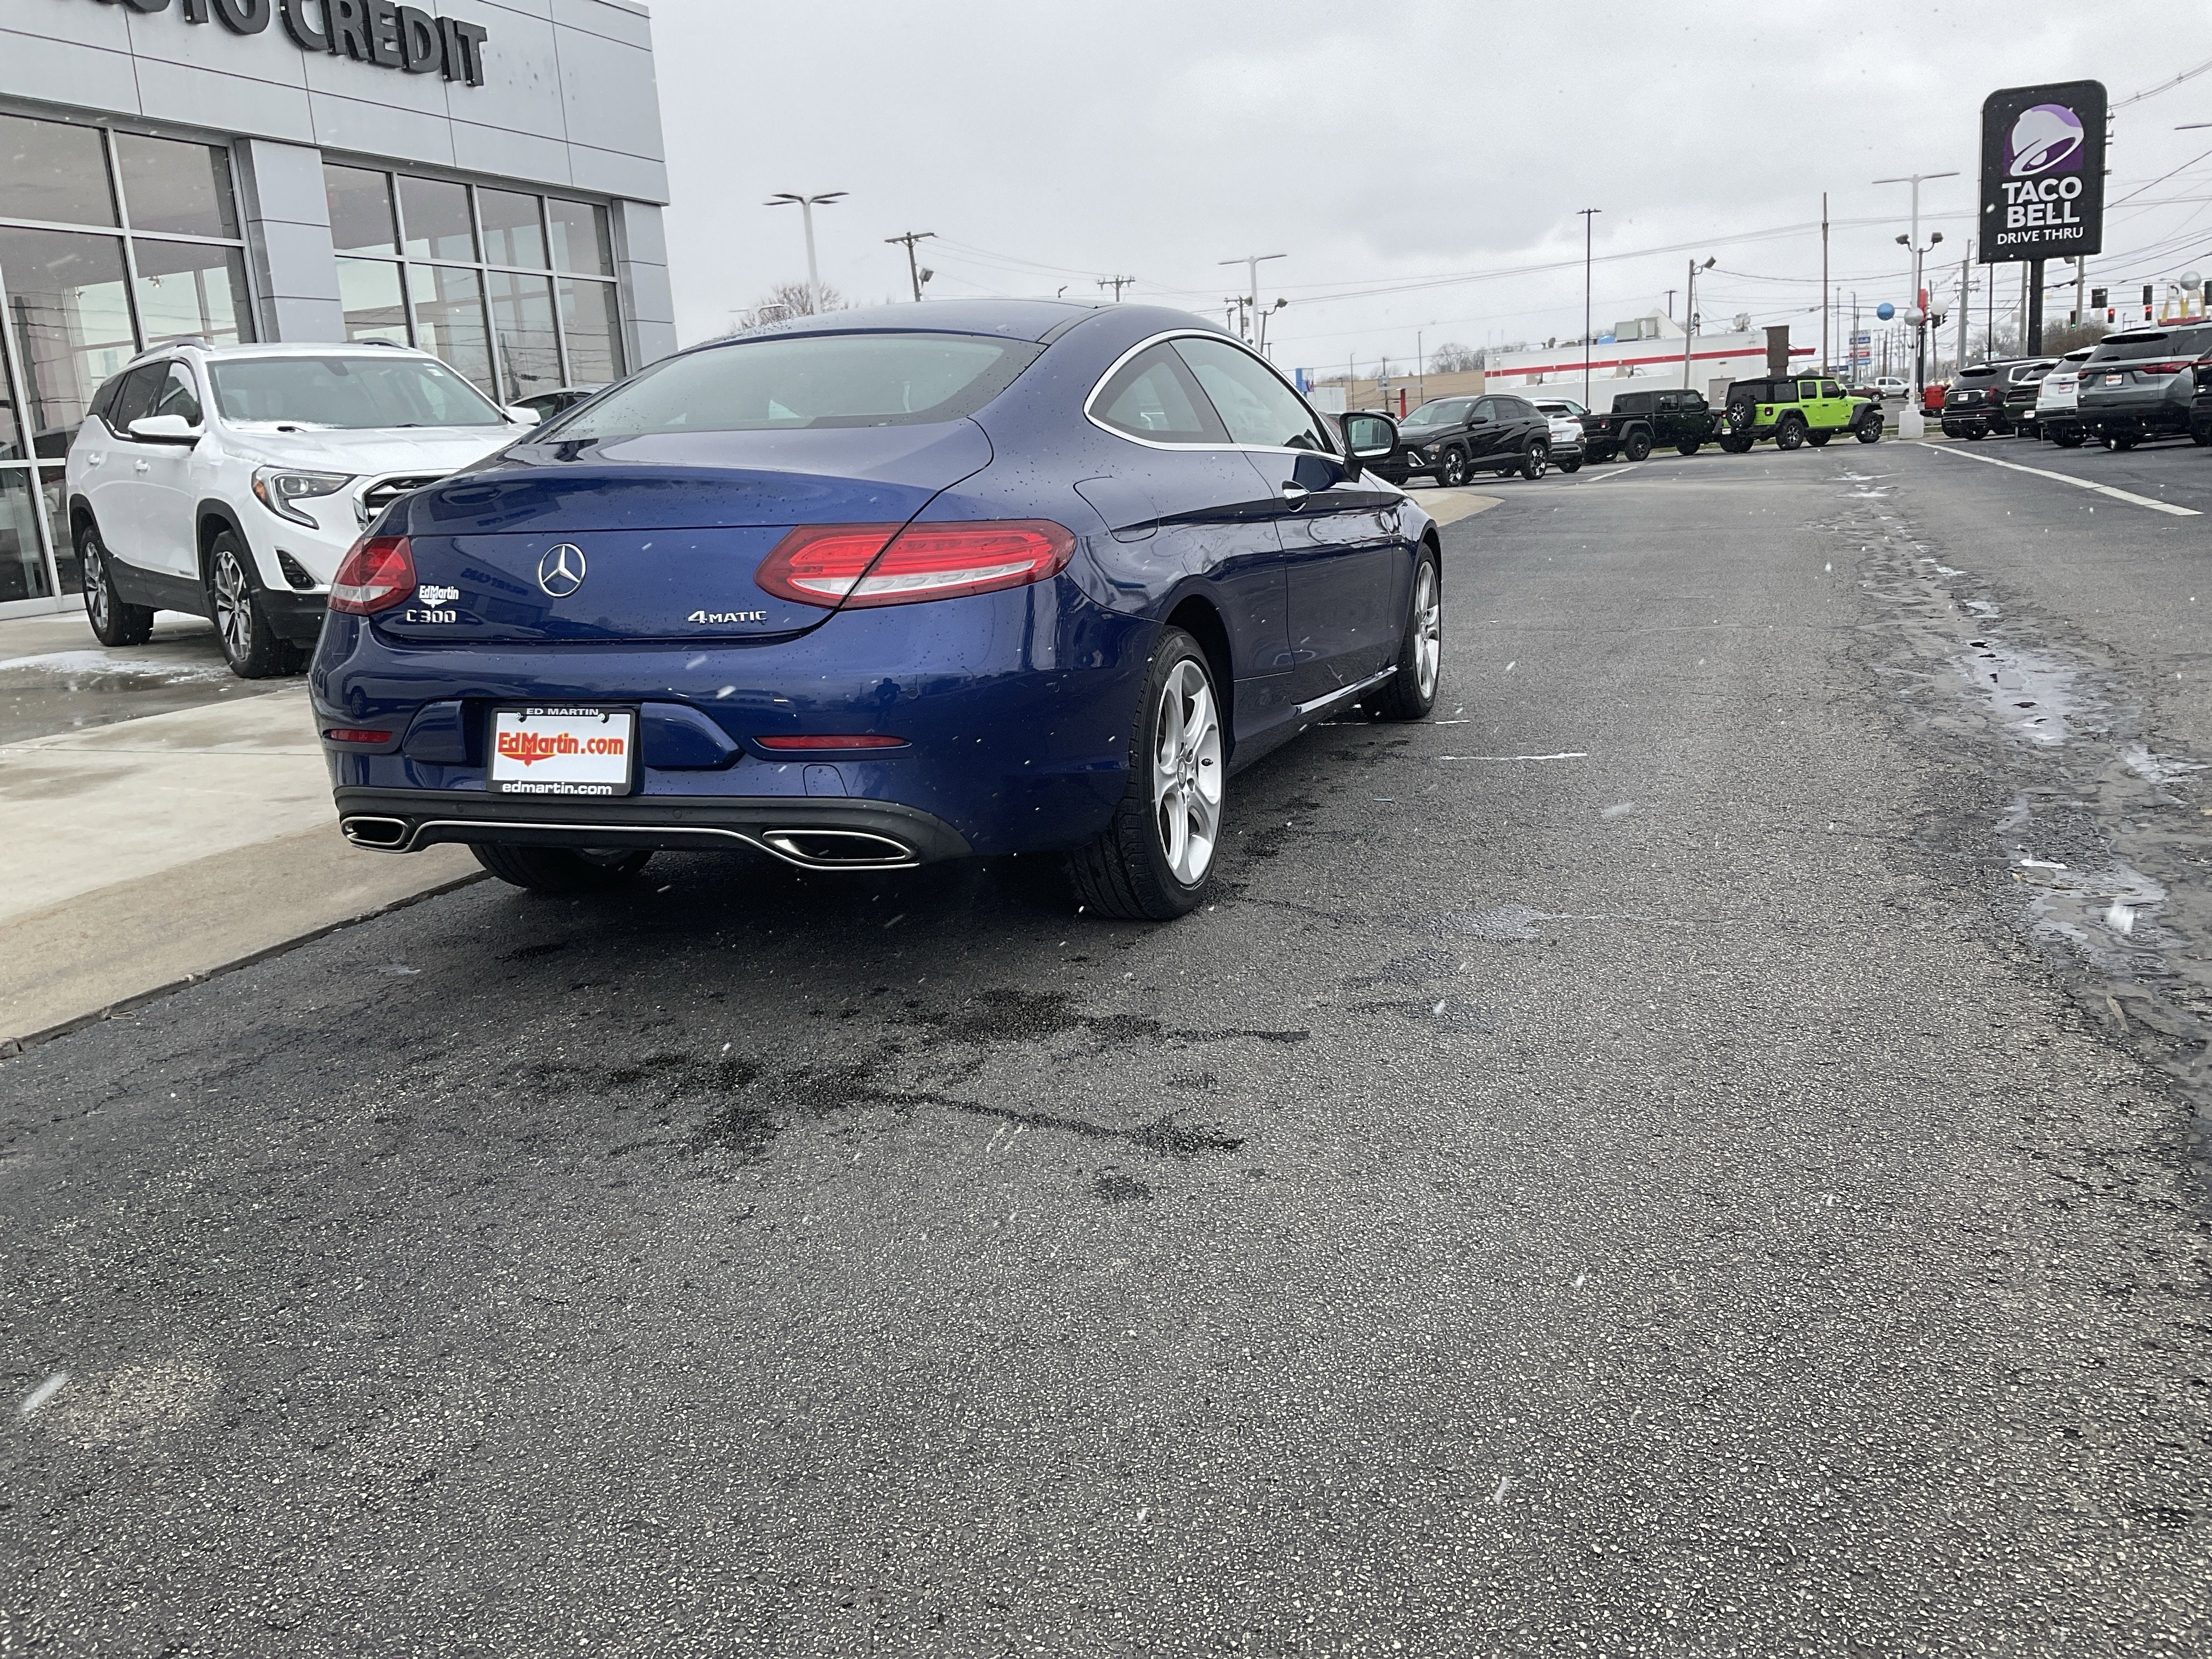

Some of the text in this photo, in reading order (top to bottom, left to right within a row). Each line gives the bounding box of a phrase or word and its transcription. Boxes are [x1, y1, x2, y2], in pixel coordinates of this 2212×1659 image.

[280, 0, 487, 87] CREDIT
[2002, 177, 2083, 204] TACO
[2007, 201, 2080, 228] BELL
[1997, 227, 2084, 245] DRIVE THRU
[419, 585, 459, 600] EdMartin
[407, 610, 456, 623] C 300
[687, 610, 767, 624] 4MATIC
[498, 732, 624, 755] EdMartin.com
[503, 781, 612, 795] edmartin.com
